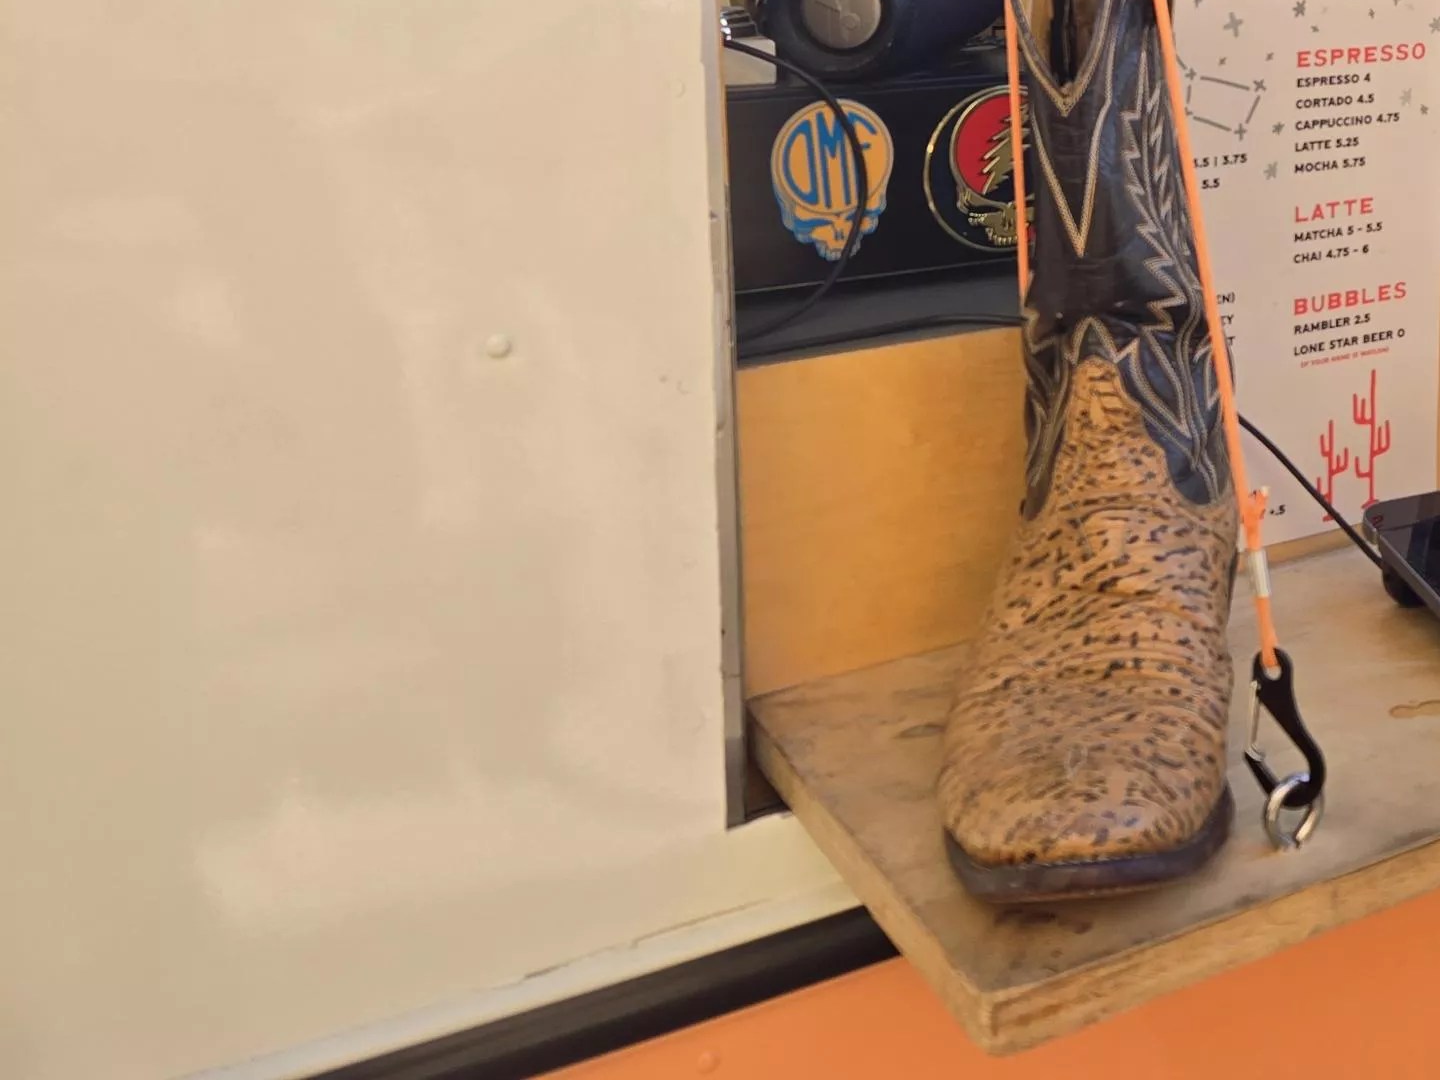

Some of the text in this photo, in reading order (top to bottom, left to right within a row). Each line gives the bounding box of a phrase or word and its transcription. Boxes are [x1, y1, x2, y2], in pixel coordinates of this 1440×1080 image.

[1296, 43, 1426, 68] ESPRESSO
[1296, 73, 1371, 88] ESPRESSO 4
[1296, 93, 1375, 109] CORTADO 4.5
[1295, 112, 1400, 131] CAPPUCCINO 4.75
[1295, 137, 1359, 152] LATTE 5.25
[1294, 157, 1366, 173] MOCHA 5.75
[1295, 197, 1374, 223] LATTE
[1294, 227, 1343, 242] MATCHA
[1347, 225, 1354, 236] 5
[1366, 222, 1383, 233] 5.5
[1293, 251, 1322, 264] CHAI
[1326, 246, 1350, 259] 4.75
[1362, 244, 1369, 254] 6
[1294, 281, 1407, 316] BUBBLES
[1294, 313, 1371, 335] RAMBLER 2.5
[1294, 342, 1325, 357] LONE
[1329, 336, 1358, 350] STAR
[1363, 330, 1393, 344] BEER
